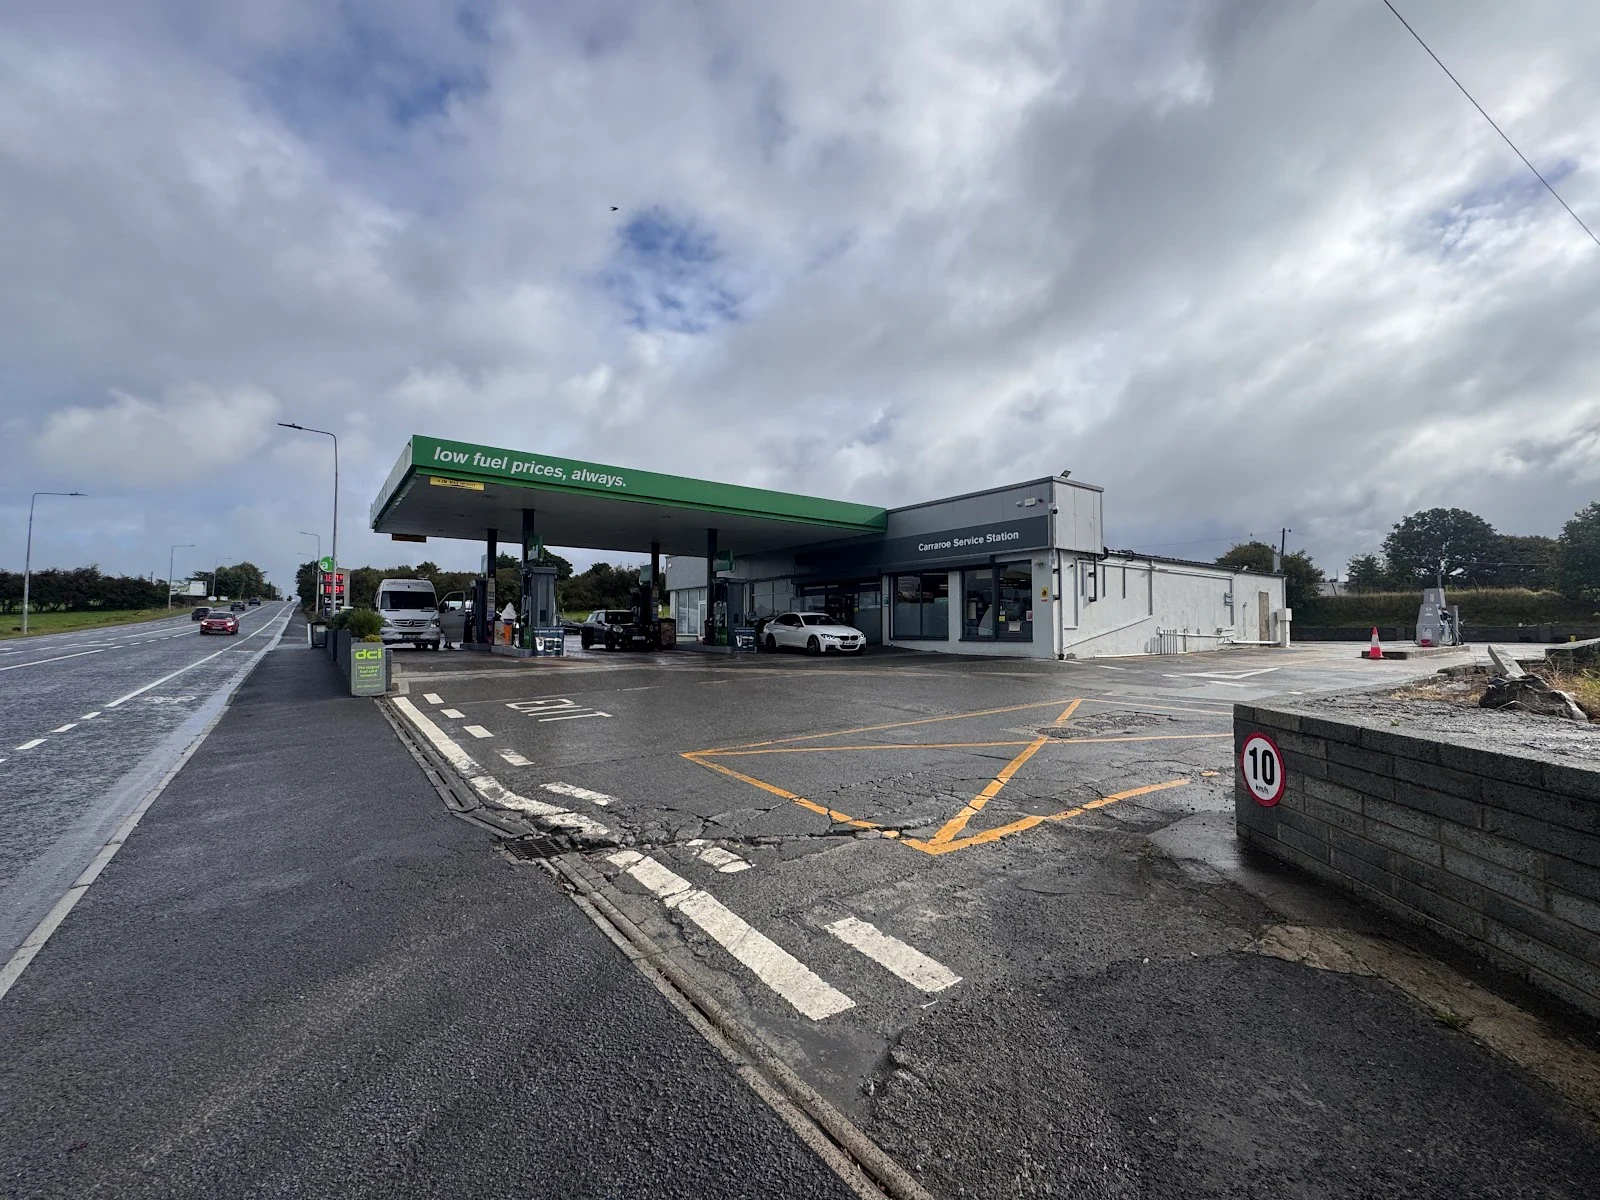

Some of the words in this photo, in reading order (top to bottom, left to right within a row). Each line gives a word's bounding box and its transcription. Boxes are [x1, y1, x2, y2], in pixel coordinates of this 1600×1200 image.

[434, 446, 469, 464] low
[473, 452, 508, 470] fuel
[511, 460, 567, 481] prices,
[571, 468, 627, 488] always.
[918, 540, 952, 552] Carraroe
[953, 536, 984, 548] Service
[986, 531, 1019, 543] Station
[355, 648, 382, 660] dci
[1248, 746, 1275, 786] 10
[1255, 784, 1270, 795] km/h
